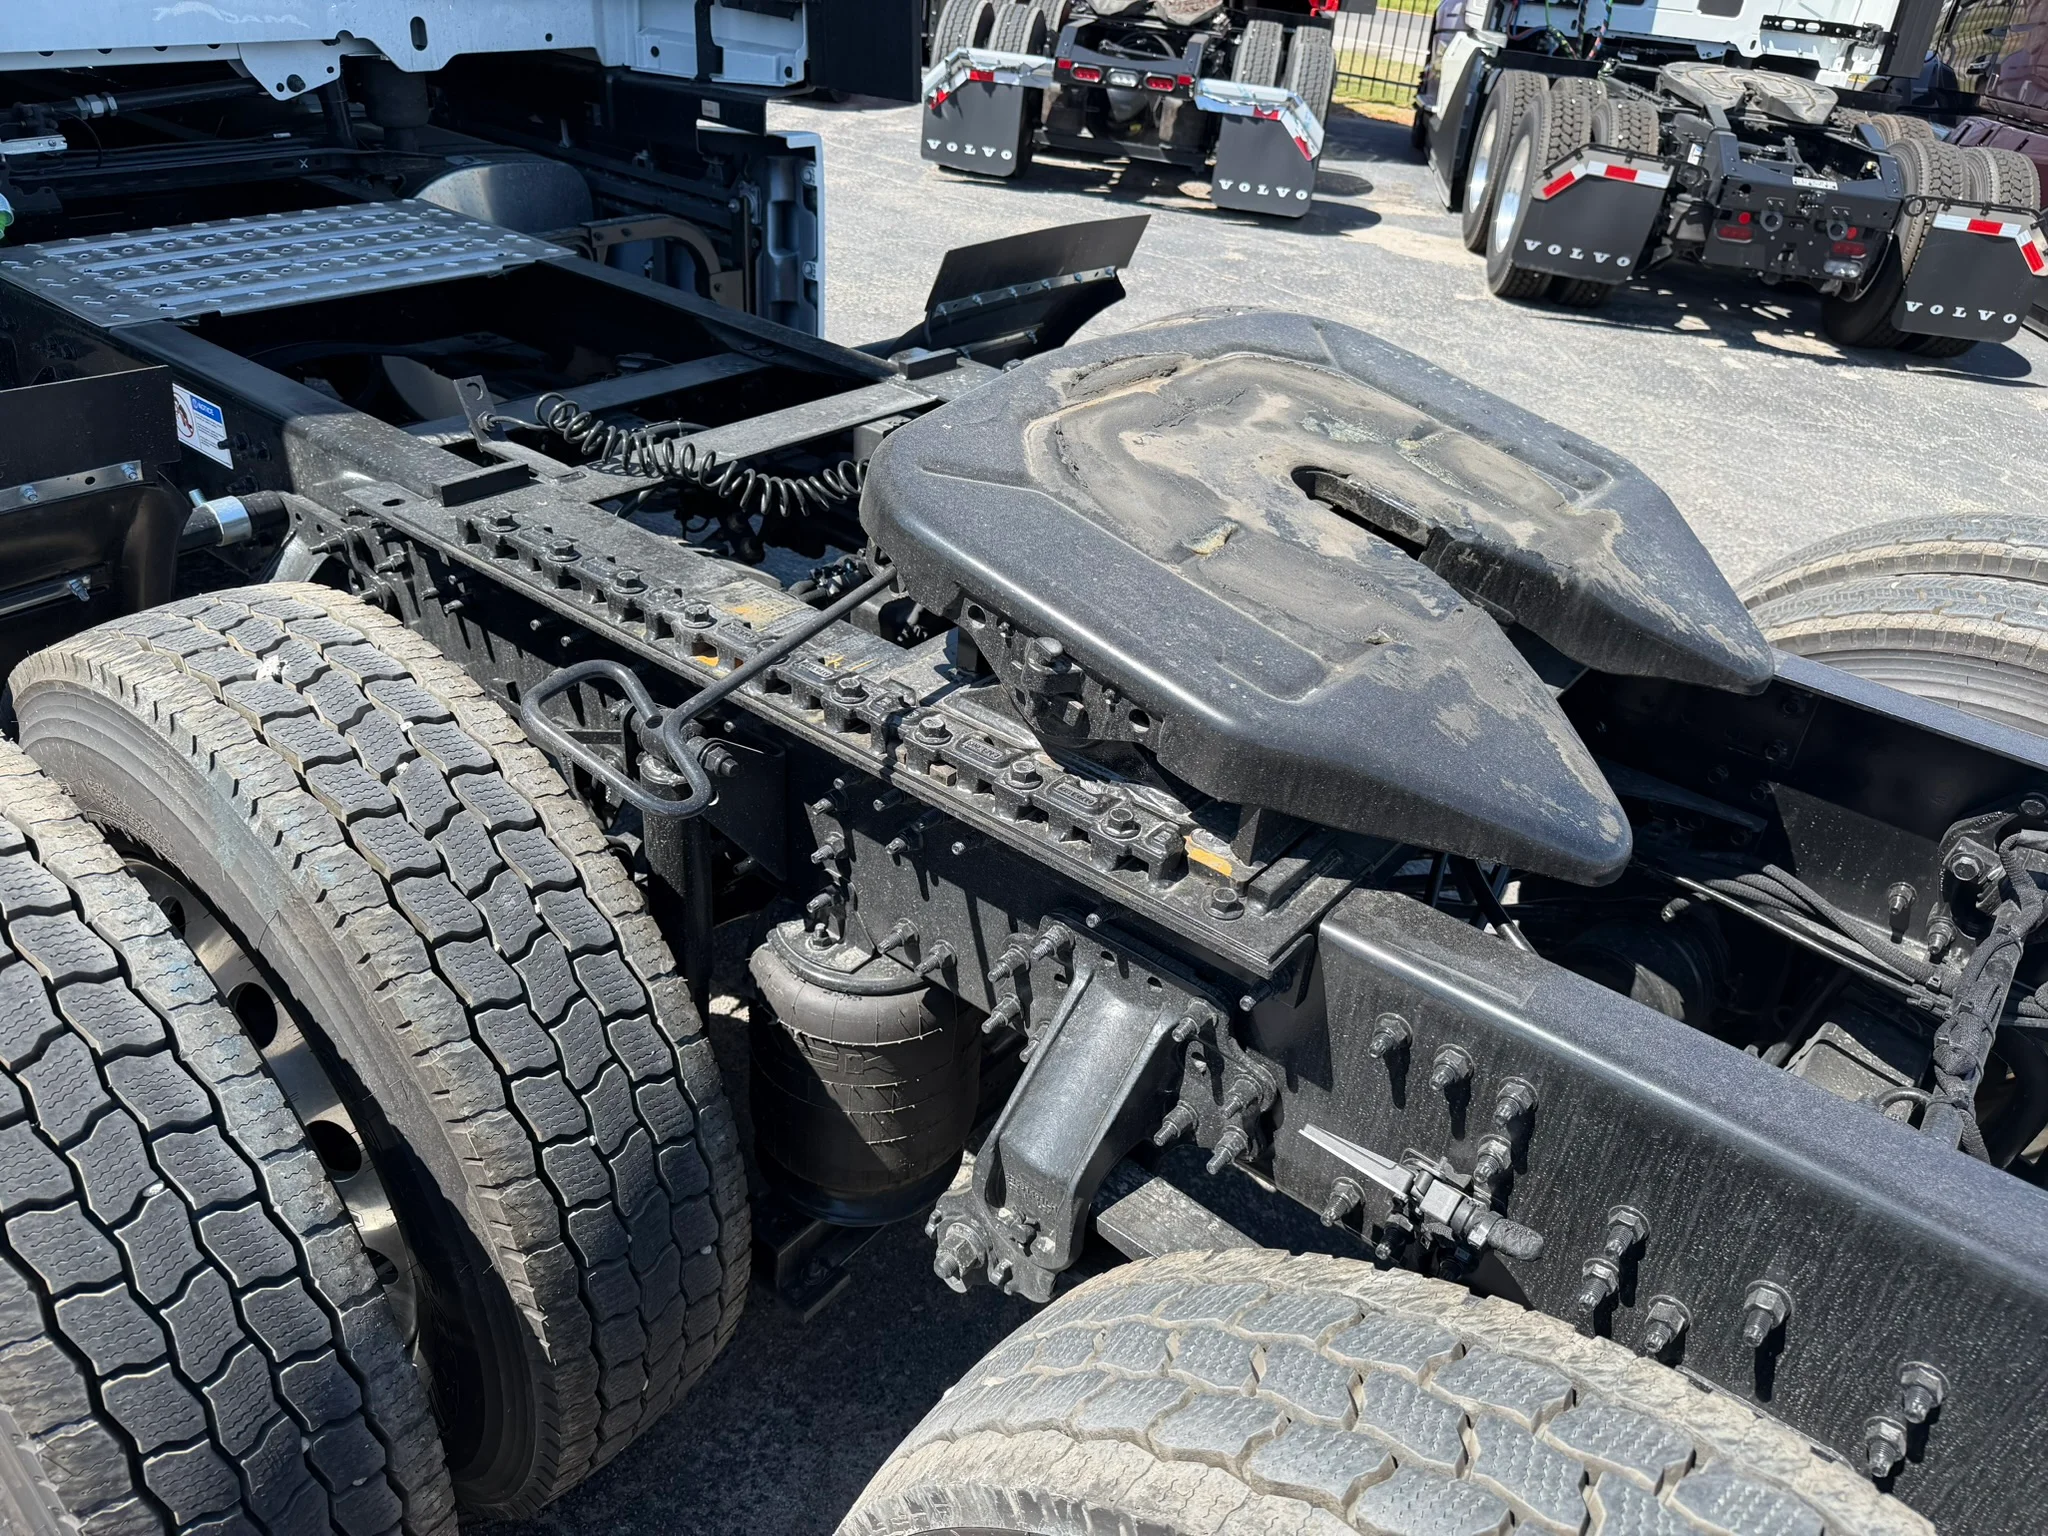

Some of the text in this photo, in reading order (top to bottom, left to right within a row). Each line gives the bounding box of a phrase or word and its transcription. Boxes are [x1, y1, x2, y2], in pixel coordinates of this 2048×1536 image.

[926, 138, 1013, 161] VOLVO
[1218, 178, 1308, 201] VOLVO
[1523, 238, 1631, 267] VOLVO
[1905, 300, 2018, 324] VOLVO
